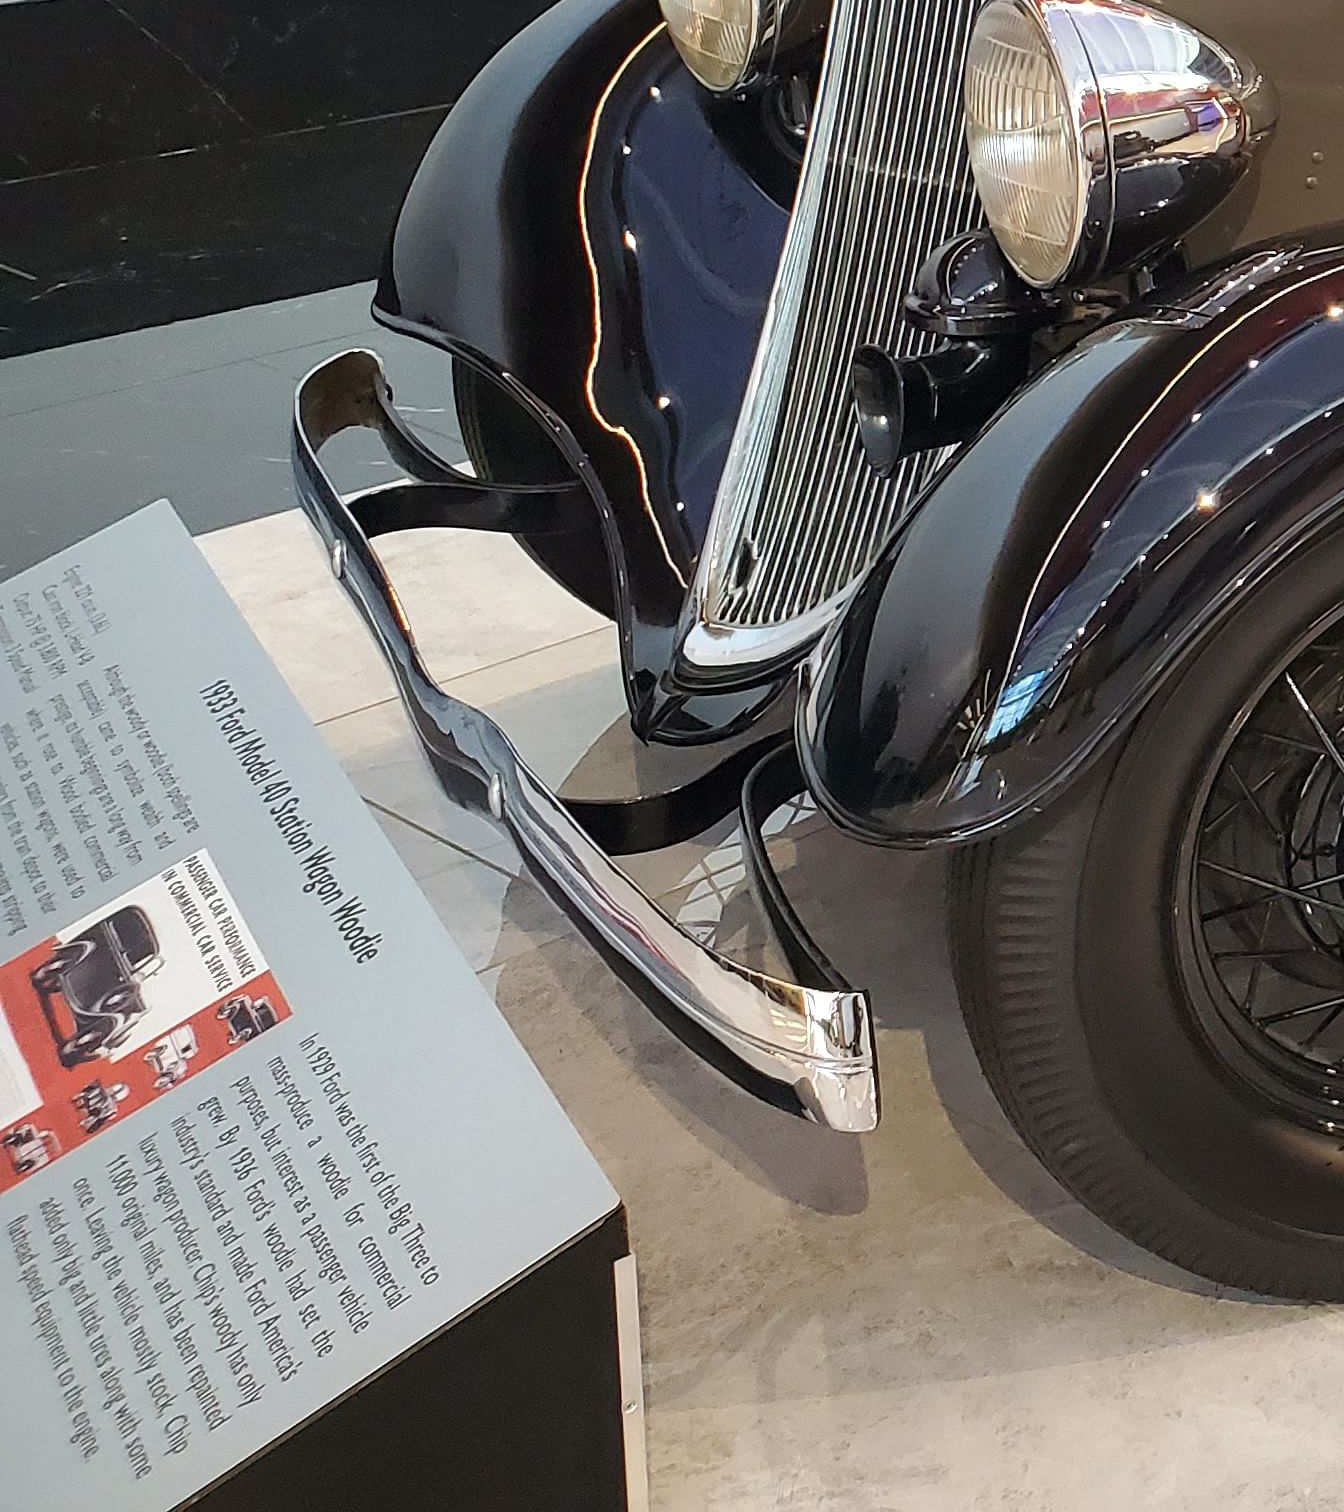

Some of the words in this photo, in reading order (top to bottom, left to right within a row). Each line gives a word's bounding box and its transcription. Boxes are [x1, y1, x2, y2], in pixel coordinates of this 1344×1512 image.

[199, 679, 238, 714] 1933
[215, 708, 257, 744] Ford
[232, 736, 282, 786] Model
[259, 780, 293, 803] 40
[269, 797, 314, 855] Station
[163, 868, 178, 883] IN
[183, 855, 218, 901] PASSENGER
[299, 845, 344, 906] Wagon
[167, 880, 206, 937] COMMERCIAL
[208, 897, 228, 919] CAR
[196, 934, 216, 957] CAR
[217, 915, 256, 979] PERFORMANCE
[329, 895, 383, 964] Woodie
[204, 954, 233, 993] SERVICE
[298, 1032, 319, 1052] In
[306, 1046, 336, 1076] 1929
[229, 1075, 269, 1131] purposes,
[319, 1071, 351, 1105] Ford
[334, 1101, 356, 1127] was
[138, 1131, 165, 1176] luxury
[171, 1115, 210, 1170] industry's
[215, 1125, 240, 1149] By
[260, 1123, 282, 1153] but
[345, 1123, 369, 1148] the
[228, 1146, 258, 1181] 1936
[271, 1146, 304, 1198] interest
[356, 1141, 381, 1174] first
[152, 1170, 180, 1213] wagon
[193, 1169, 234, 1222] standard
[267, 1055, 314, 1131] mass-produce
[307, 1135, 322, 1149] a
[317, 1152, 351, 1200] woodie
[343, 1202, 365, 1227] for
[358, 1236, 412, 1311] commercial
[370, 1171, 396, 1188] of
[377, 1184, 401, 1210] the
[39, 1197, 70, 1235] added
[120, 1196, 157, 1242] original
[243, 1178, 276, 1222] Ford's
[293, 1195, 312, 1214] as
[301, 1212, 317, 1226] a
[388, 1202, 413, 1235] Big
[7, 1214, 40, 1267] flathead
[52, 1233, 77, 1263] only
[85, 1206, 114, 1261] Leaving
[216, 1220, 245, 1247] and
[263, 1222, 296, 1272] woodie
[400, 1222, 430, 1269] Three
[58, 1256, 81, 1286] big
[102, 1255, 125, 1281] the
[138, 1240, 165, 1281] miles,
[227, 1246, 258, 1284] made
[299, 1223, 348, 1285] passenger
[17, 1264, 54, 1303] speed
[69, 1280, 95, 1307] and
[153, 1277, 182, 1305] and
[193, 1263, 225, 1307] Chip's
[284, 1269, 315, 1302] had
[420, 1265, 439, 1286] to
[111, 1279, 143, 1327] vehicle
[163, 1299, 185, 1330] has
[244, 1277, 276, 1317] Ford
[337, 1285, 373, 1334] vehicle
[31, 1300, 71, 1371] equipment
[78, 1299, 105, 1337] little
[209, 1303, 243, 1353] woody
[298, 1303, 320, 1330] set
[89, 1334, 112, 1369] tires
[129, 1325, 162, 1375] mostly
[172, 1323, 199, 1365] been
[227, 1343, 249, 1376] has
[258, 1314, 303, 1382] America's
[311, 1329, 336, 1358] the
[57, 1367, 75, 1388] to
[99, 1366, 126, 1410] along
[146, 1372, 178, 1419] stock,
[237, 1373, 265, 1408] only
[63, 1385, 85, 1413] the
[185, 1363, 233, 1431] repainted
[114, 1403, 143, 1440] with
[164, 1414, 188, 1456] Chip
[125, 1436, 152, 1480] some
